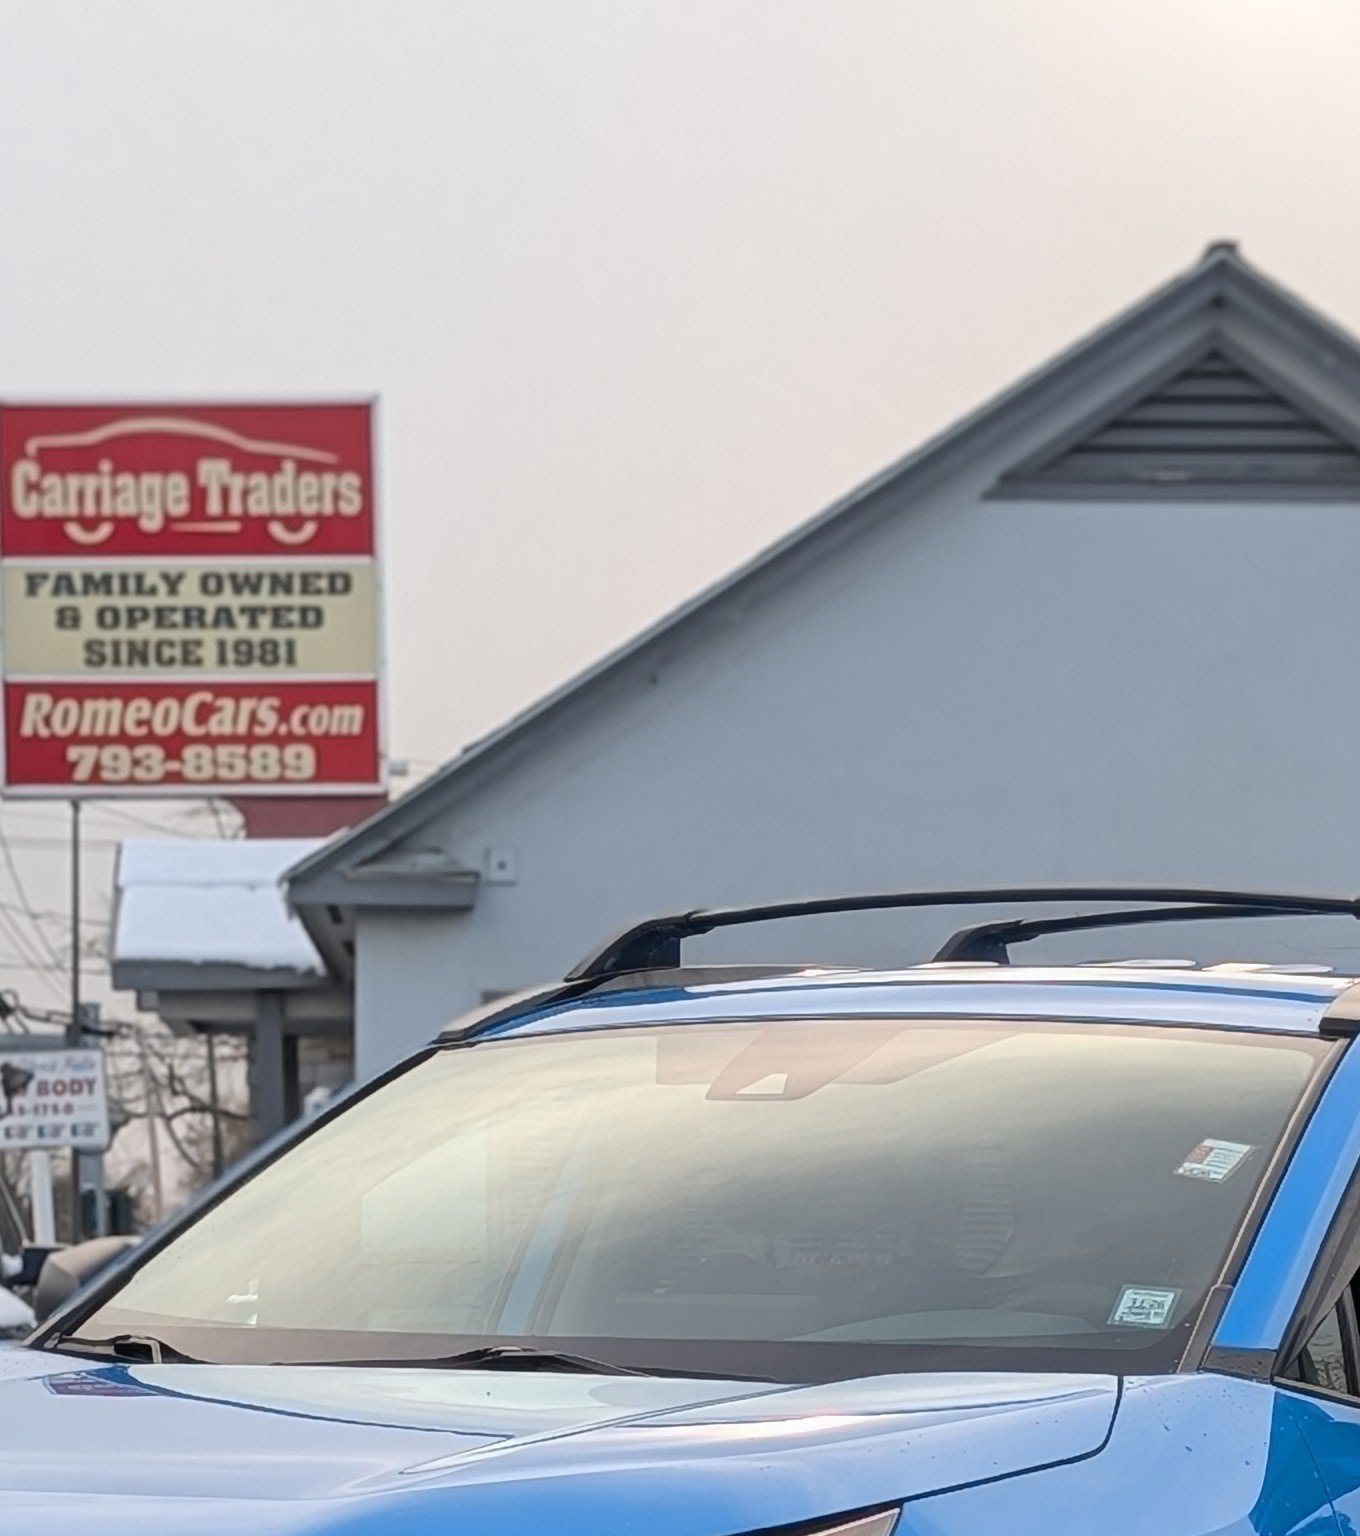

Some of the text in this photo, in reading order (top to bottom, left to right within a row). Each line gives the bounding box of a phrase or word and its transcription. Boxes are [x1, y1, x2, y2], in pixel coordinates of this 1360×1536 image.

[11, 458, 362, 533] Carriage Traders
[24, 571, 353, 597] FAMILY OWNED
[55, 605, 325, 631] & OPERATED
[83, 638, 298, 667] SINCE 1981
[19, 691, 365, 738] RomeoCars.com
[66, 743, 316, 781] 793-8589
[36, 1077, 96, 1097] BODY
